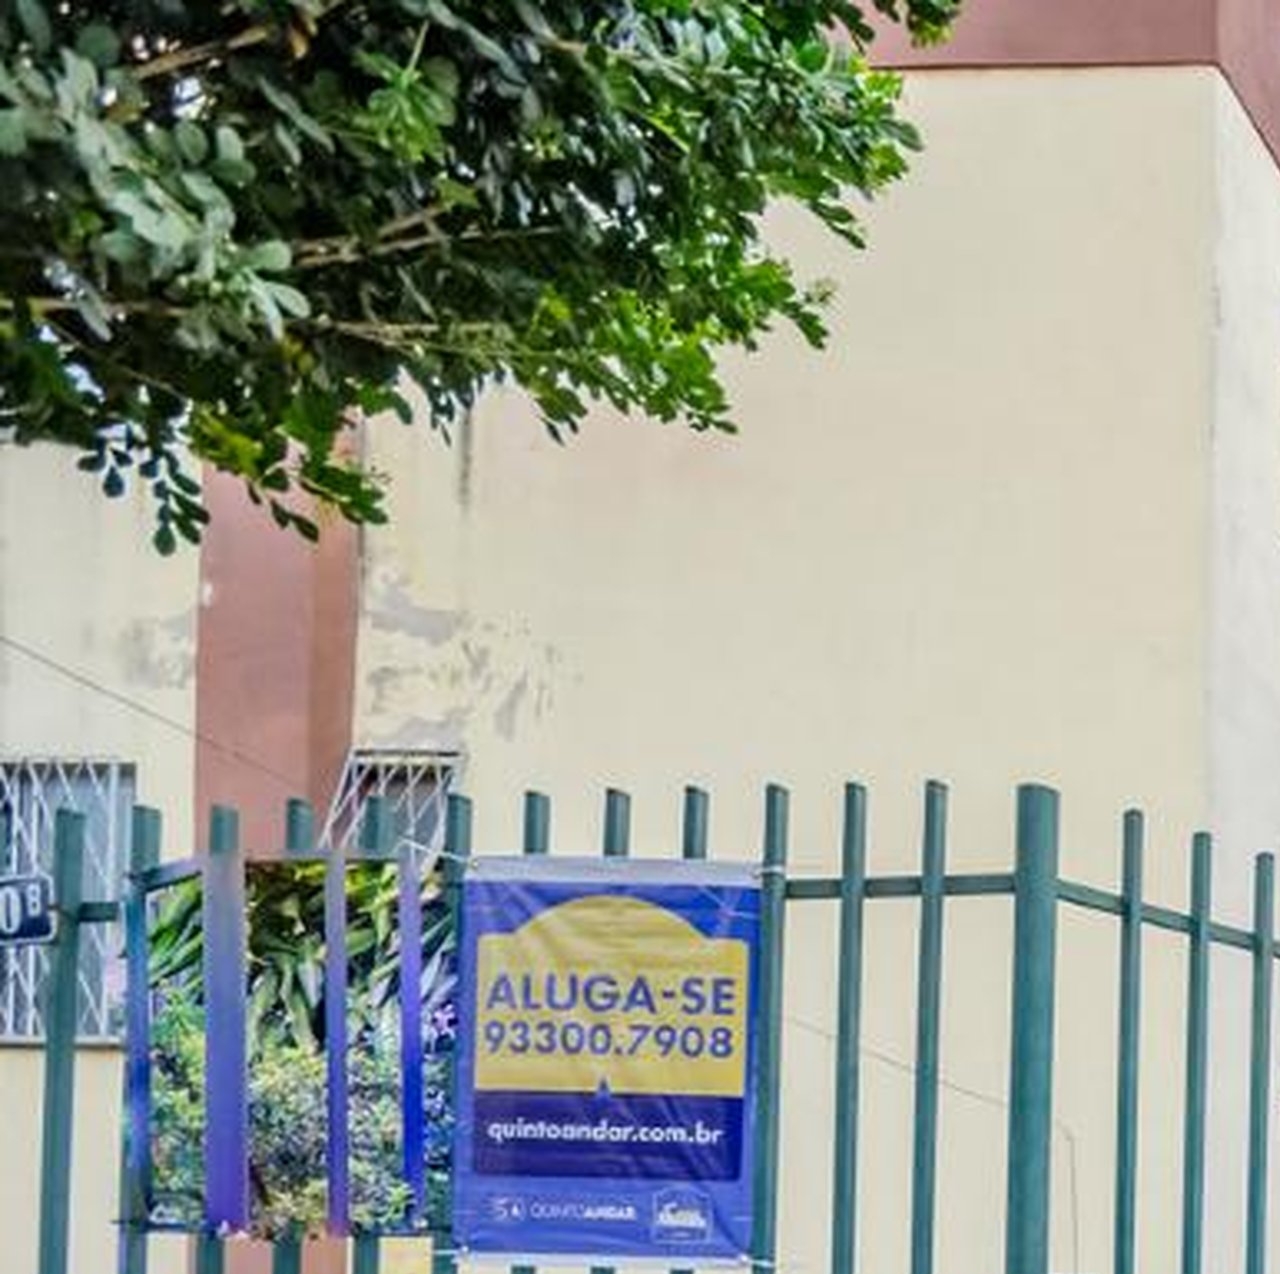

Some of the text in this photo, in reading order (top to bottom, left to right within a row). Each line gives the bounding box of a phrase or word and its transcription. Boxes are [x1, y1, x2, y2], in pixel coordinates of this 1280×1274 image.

[487, 973, 736, 1016] ALUGA-SE
[485, 1020, 734, 1058] 93300.7908
[487, 1117, 724, 1144] quintoandar.com.br
